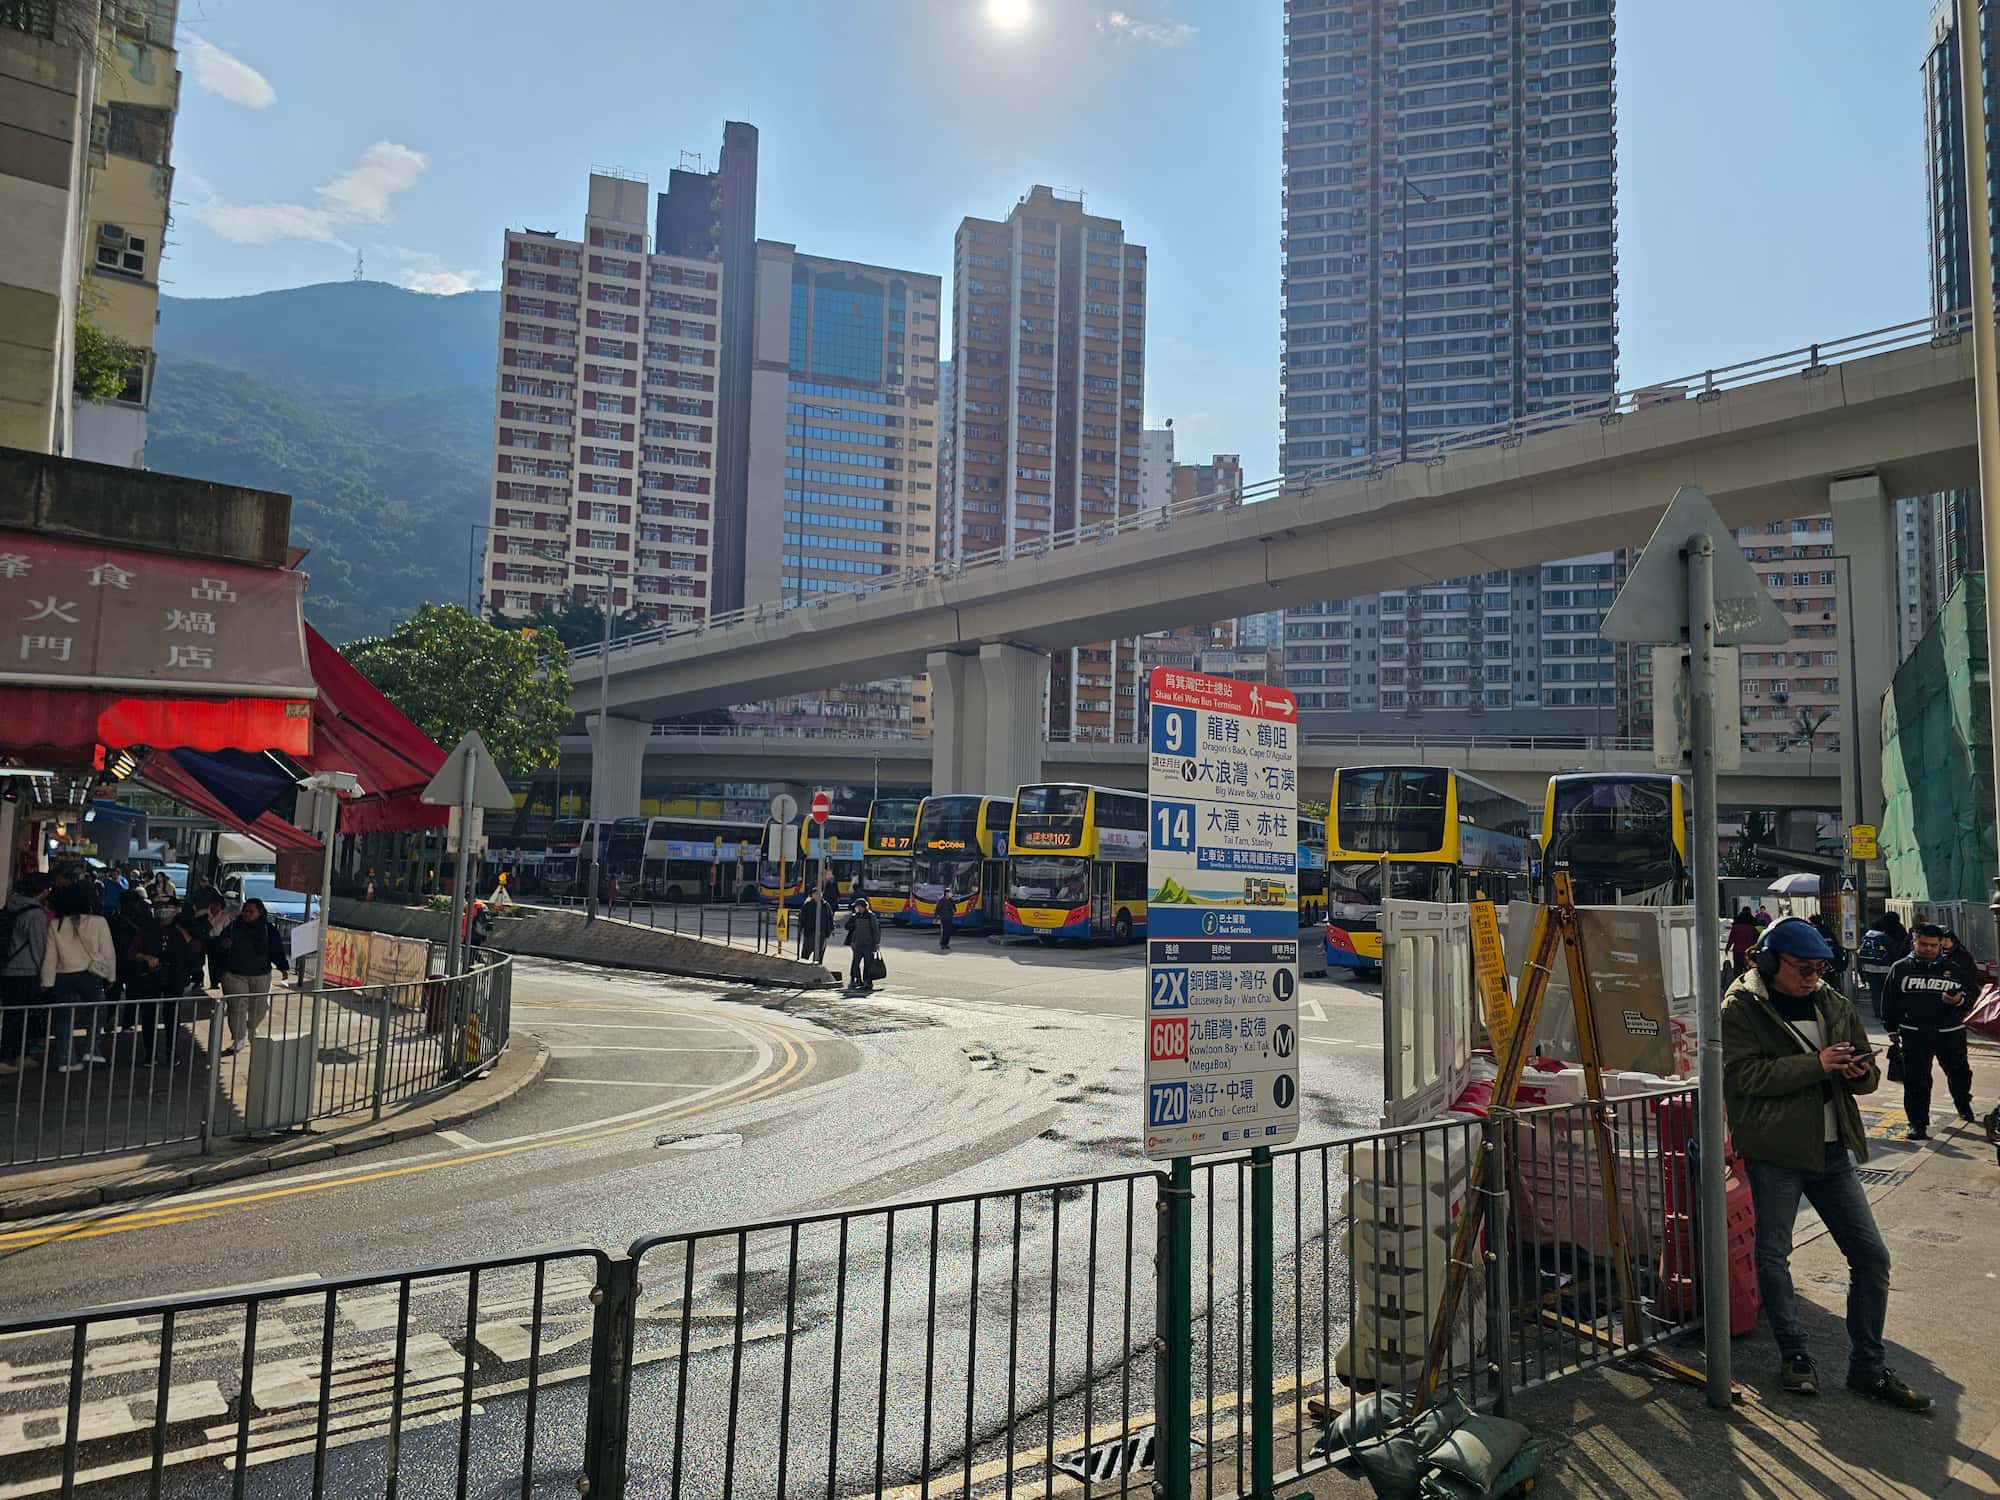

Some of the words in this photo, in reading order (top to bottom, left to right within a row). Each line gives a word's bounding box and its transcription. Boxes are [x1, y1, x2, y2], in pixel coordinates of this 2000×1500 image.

[20, 634, 214, 670] 門店
[1155, 689, 1172, 701] Shau
[1173, 691, 1184, 702] Kei
[1185, 694, 1200, 705] Wan
[1201, 697, 1212, 707] Bus
[1214, 699, 1242, 711] Terminus
[1166, 713, 1182, 751] 9
[1207, 715, 1288, 750] 龍脊、鶴咀
[1202, 741, 1232, 755] Dragon's
[1232, 745, 1248, 757] Back,
[1249, 748, 1265, 760] Cape
[1266, 750, 1292, 763] D'Aguilar
[1184, 763, 1194, 780] K
[1198, 757, 1296, 792] 大浪灣、石澳
[1216, 786, 1225, 798] Big
[1227, 788, 1245, 798] Wave
[1260, 789, 1274, 800] Shek
[1275, 793, 1281, 801] O
[1157, 807, 1190, 847] 14
[1207, 806, 1288, 838] 大潭、赤柱
[899, 837, 910, 848] 77
[1054, 833, 1071, 846] 102
[1224, 836, 1234, 845] Tai
[1235, 837, 1250, 847] Tam,
[1251, 838, 1274, 849] Stanley
[1842, 878, 1854, 890] A
[1219, 926, 1229, 934] Bus
[1230, 926, 1252, 934] Services
[1211, 944, 1232, 955] 目的地
[1153, 972, 1185, 1006] 2X
[1279, 973, 1289, 998] L
[1189, 995, 1223, 1007] Causeway
[1224, 994, 1236, 1007] Bay
[1241, 994, 1254, 1003] Wan
[1257, 993, 1272, 1004] Chai
[1153, 1023, 1185, 1056] 608
[1189, 1044, 1223, 1056] Kowloon
[1225, 1043, 1238, 1056] Bay
[1244, 1041, 1255, 1051] Kai
[1256, 1040, 1270, 1051] Tak
[1276, 1028, 1292, 1053] M
[1189, 1059, 1232, 1073] (MegaBox)
[1280, 1078, 1287, 1105] J
[1152, 1087, 1185, 1122] 720
[1188, 1109, 1207, 1120] Wan
[1208, 1106, 1226, 1117] Chai
[1231, 1103, 1259, 1115] Central
